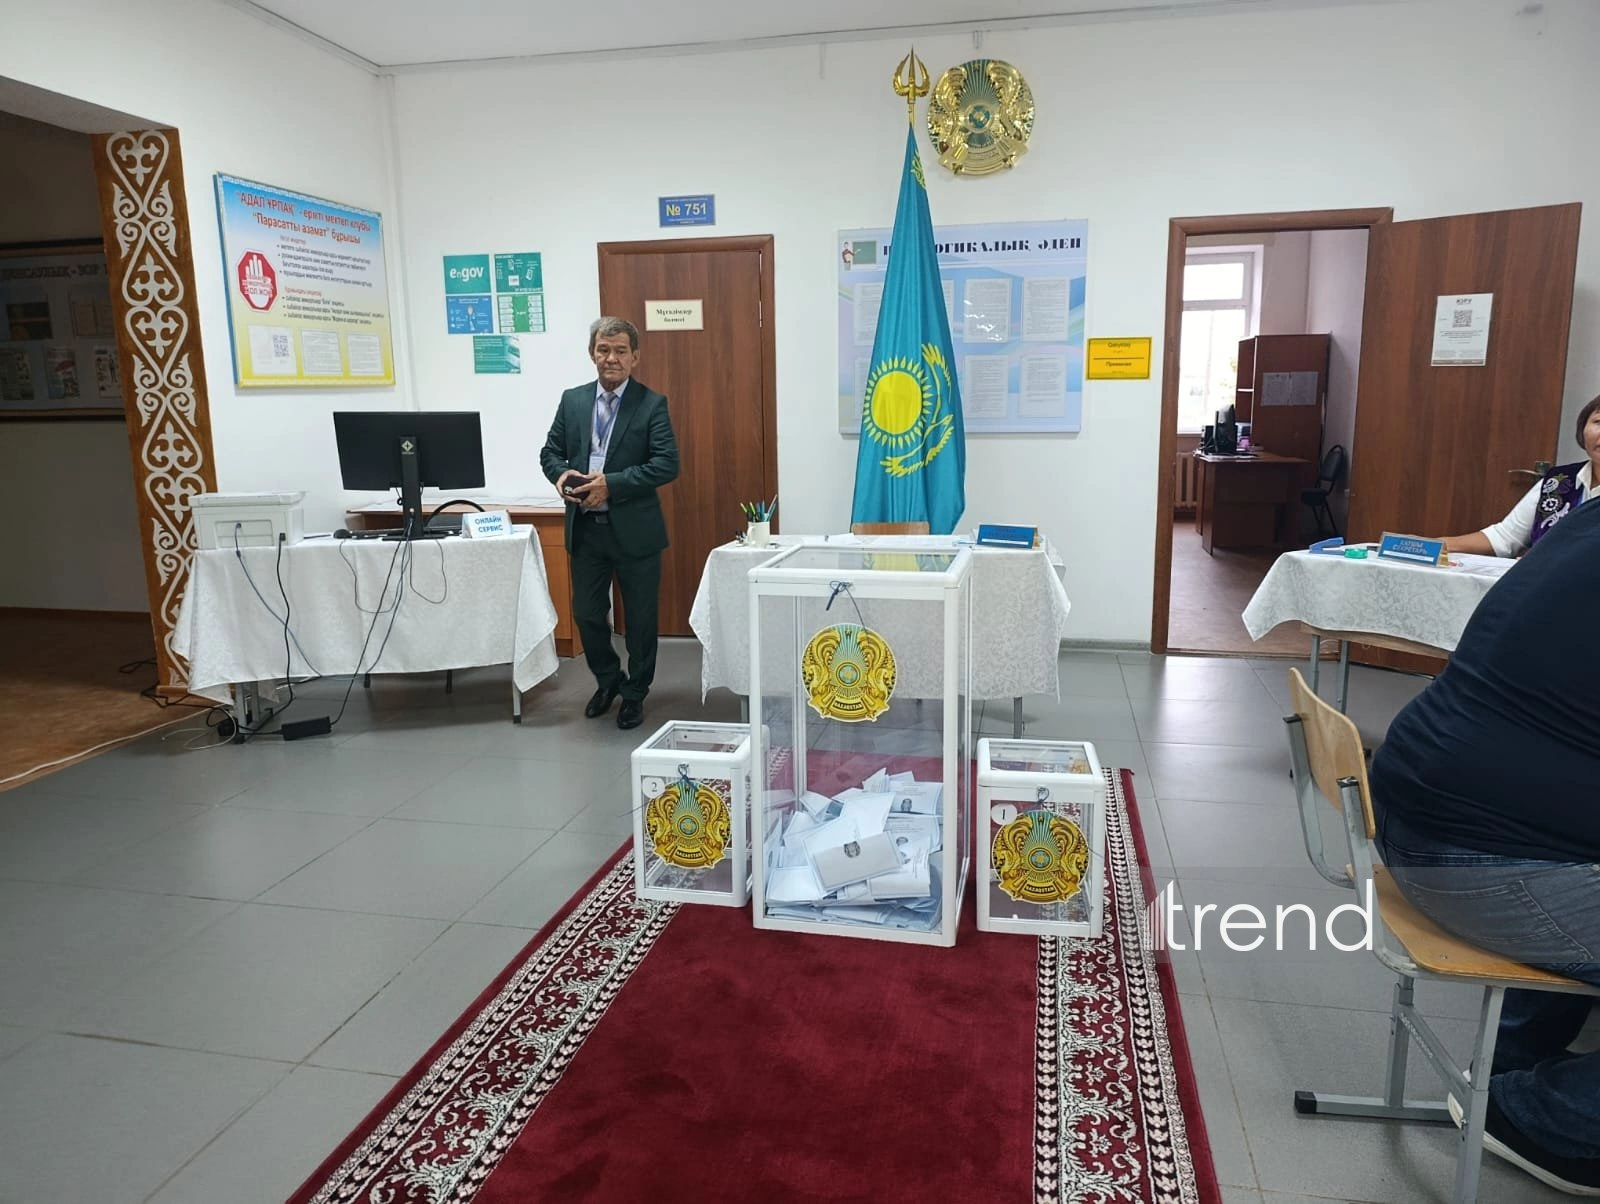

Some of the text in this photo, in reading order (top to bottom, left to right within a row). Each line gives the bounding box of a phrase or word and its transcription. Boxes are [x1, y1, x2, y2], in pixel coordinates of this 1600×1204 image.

[665, 202, 707, 217] № 751
[883, 238, 1031, 256] ПОГИКАЛЫҚ
[475, 516, 502, 524] ОНЛАЙН
[651, 782, 658, 792] 2
